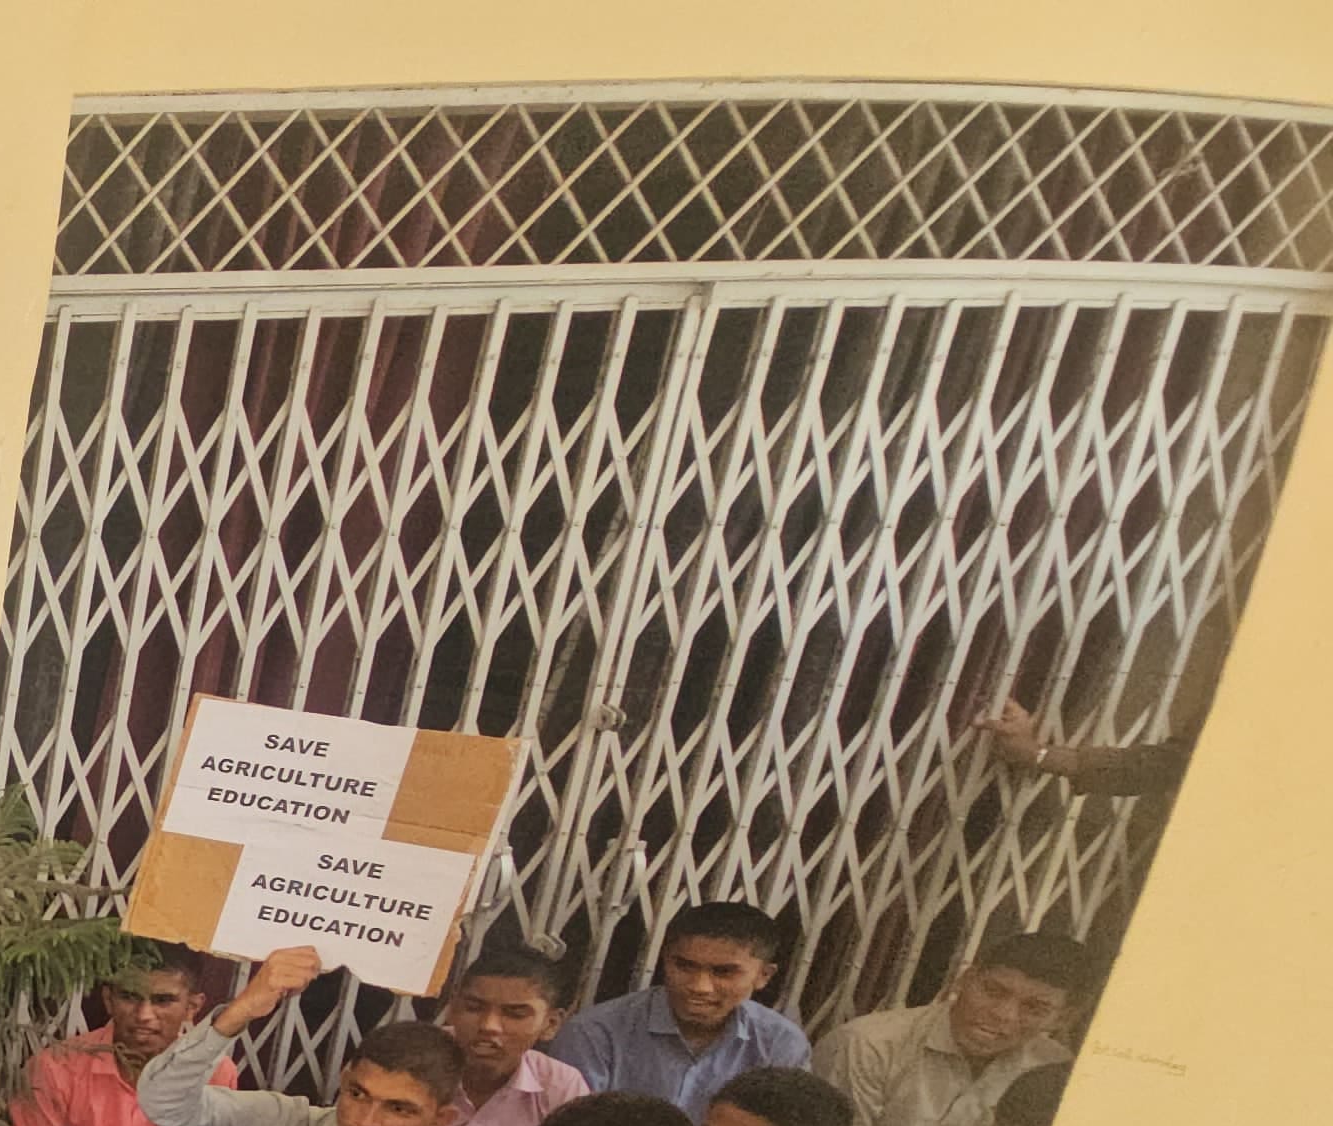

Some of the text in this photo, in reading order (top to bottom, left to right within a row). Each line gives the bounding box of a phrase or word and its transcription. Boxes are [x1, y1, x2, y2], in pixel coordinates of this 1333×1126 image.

[264, 733, 331, 758] SAVE
[200, 755, 378, 798] AGRICULTURE
[207, 787, 351, 825] EDUCATION
[317, 853, 386, 880] SAVE
[251, 873, 433, 922] AGRICULTURE
[256, 905, 405, 948] EDUCATION
